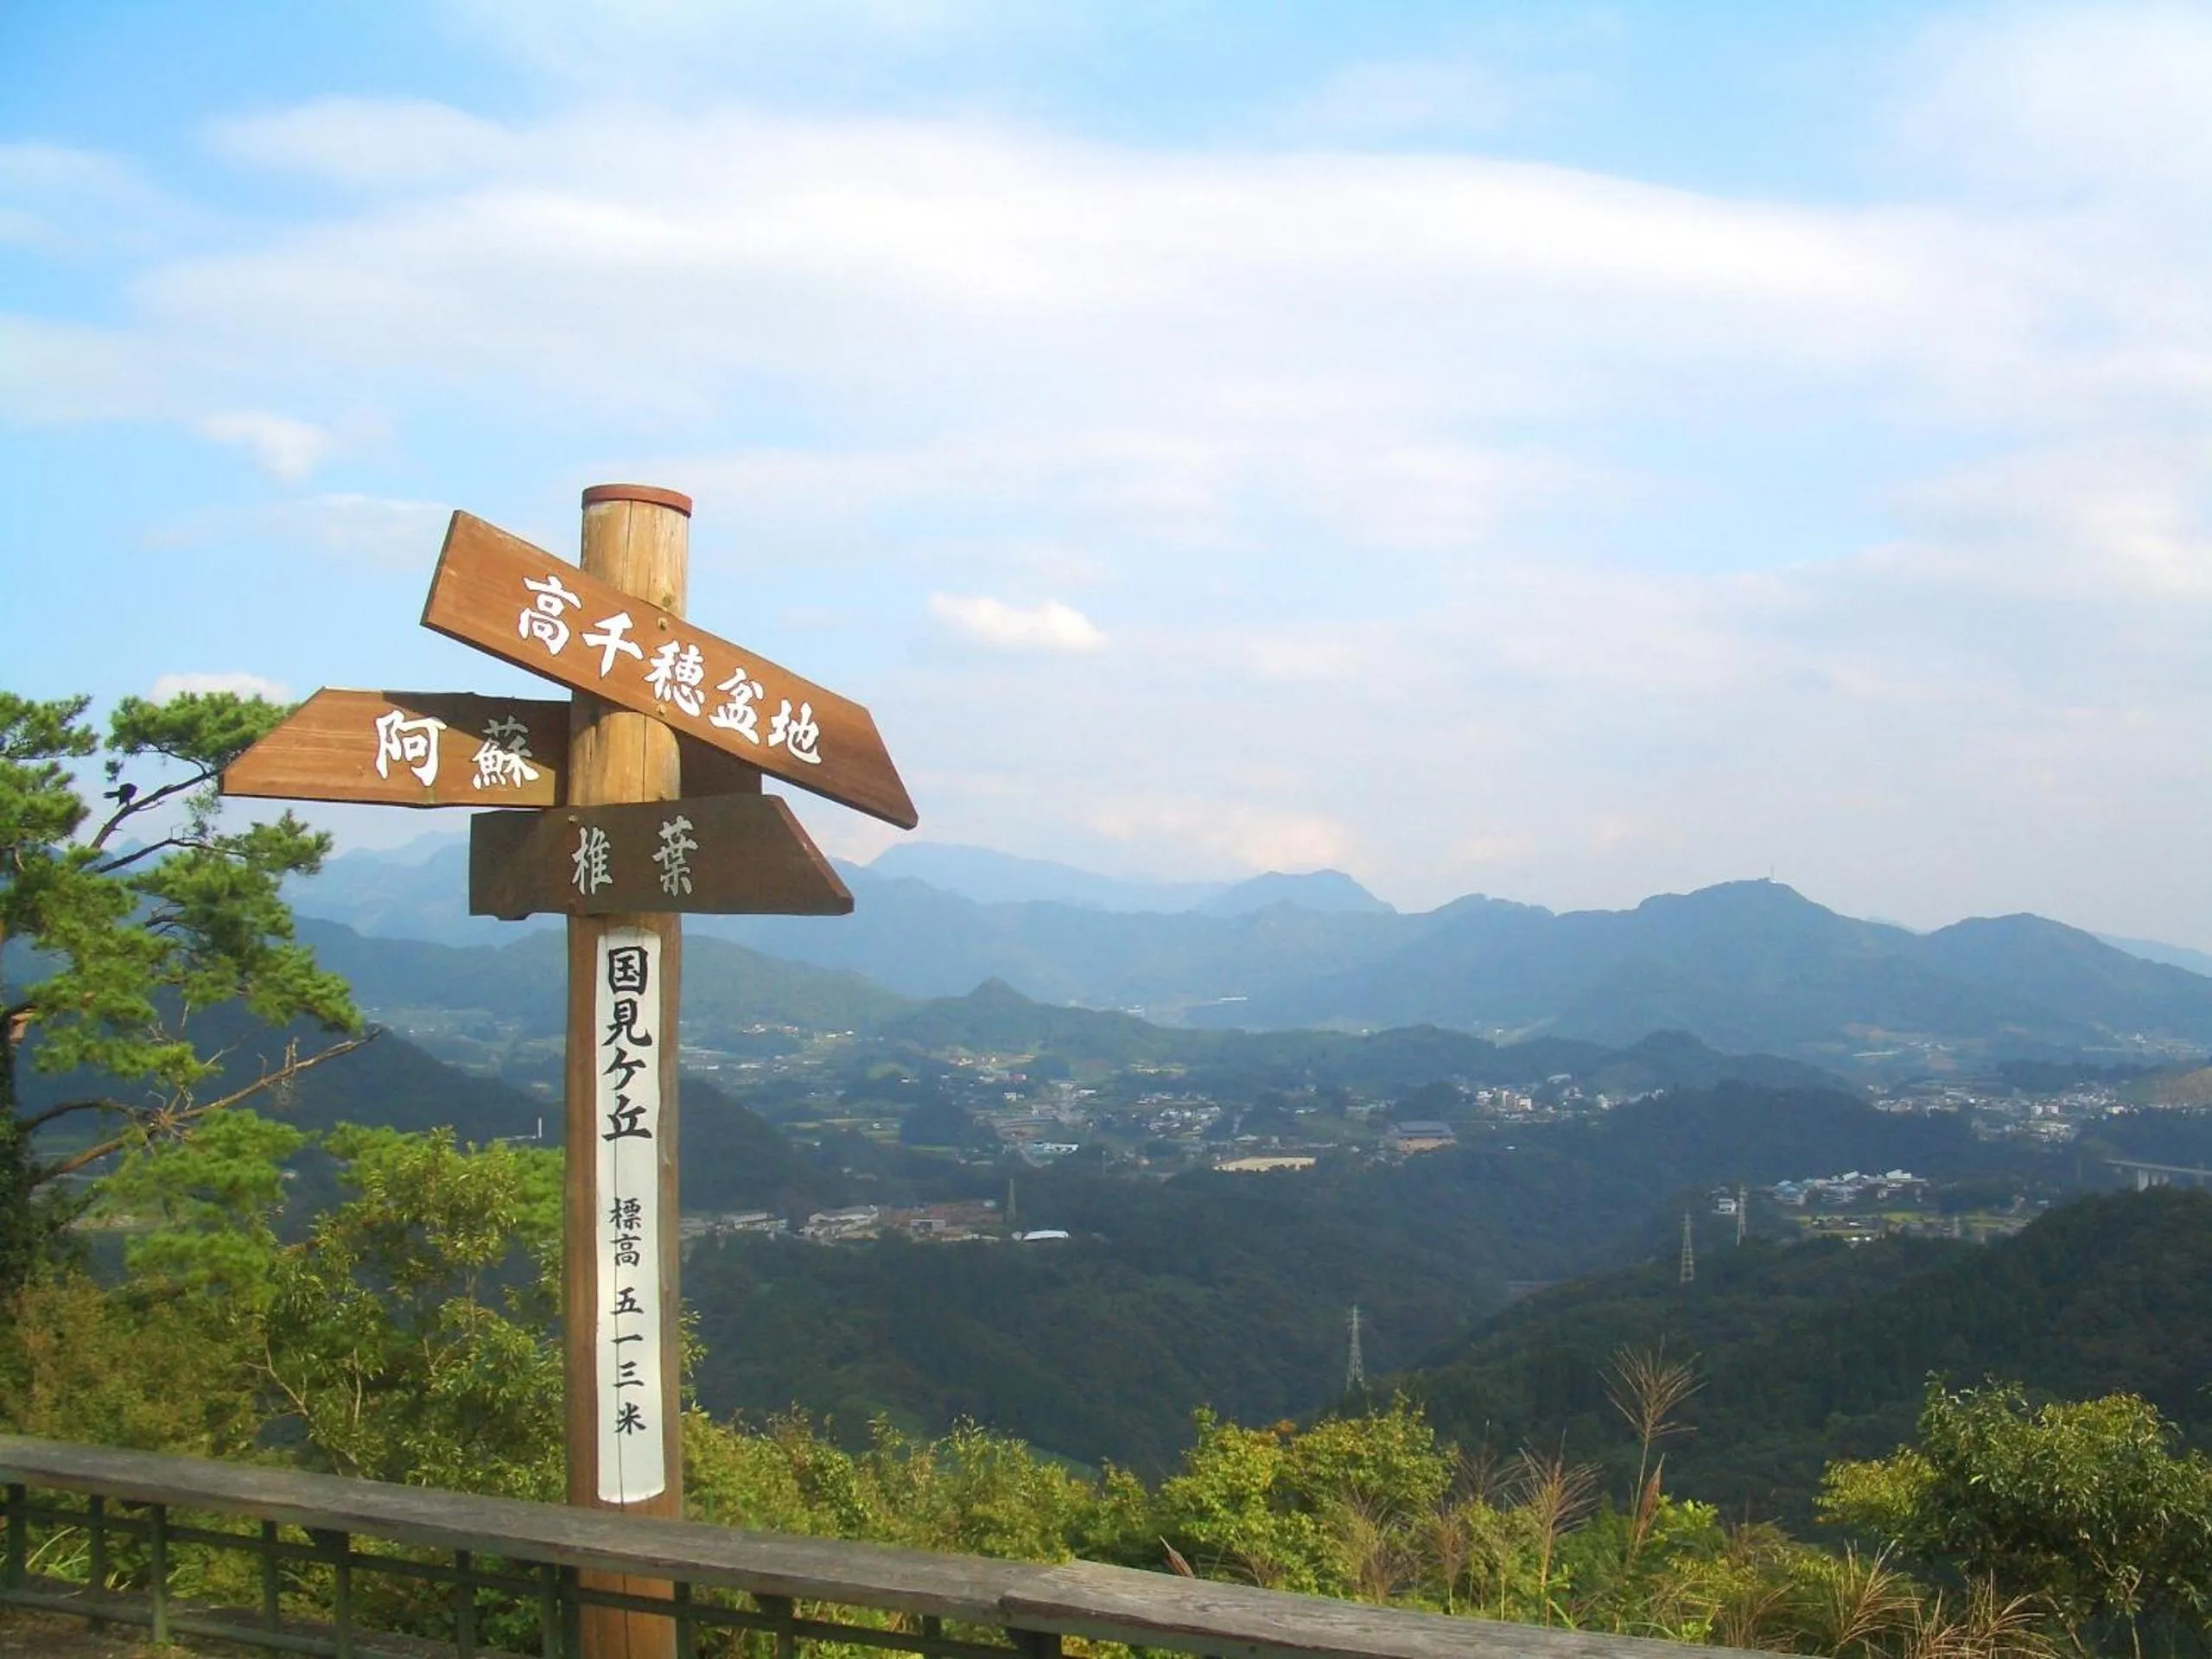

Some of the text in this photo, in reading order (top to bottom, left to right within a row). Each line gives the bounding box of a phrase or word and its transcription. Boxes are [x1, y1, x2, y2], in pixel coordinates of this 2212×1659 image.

[519, 575, 822, 765] 高千穂盆地
[375, 710, 539, 789] 阿蘇
